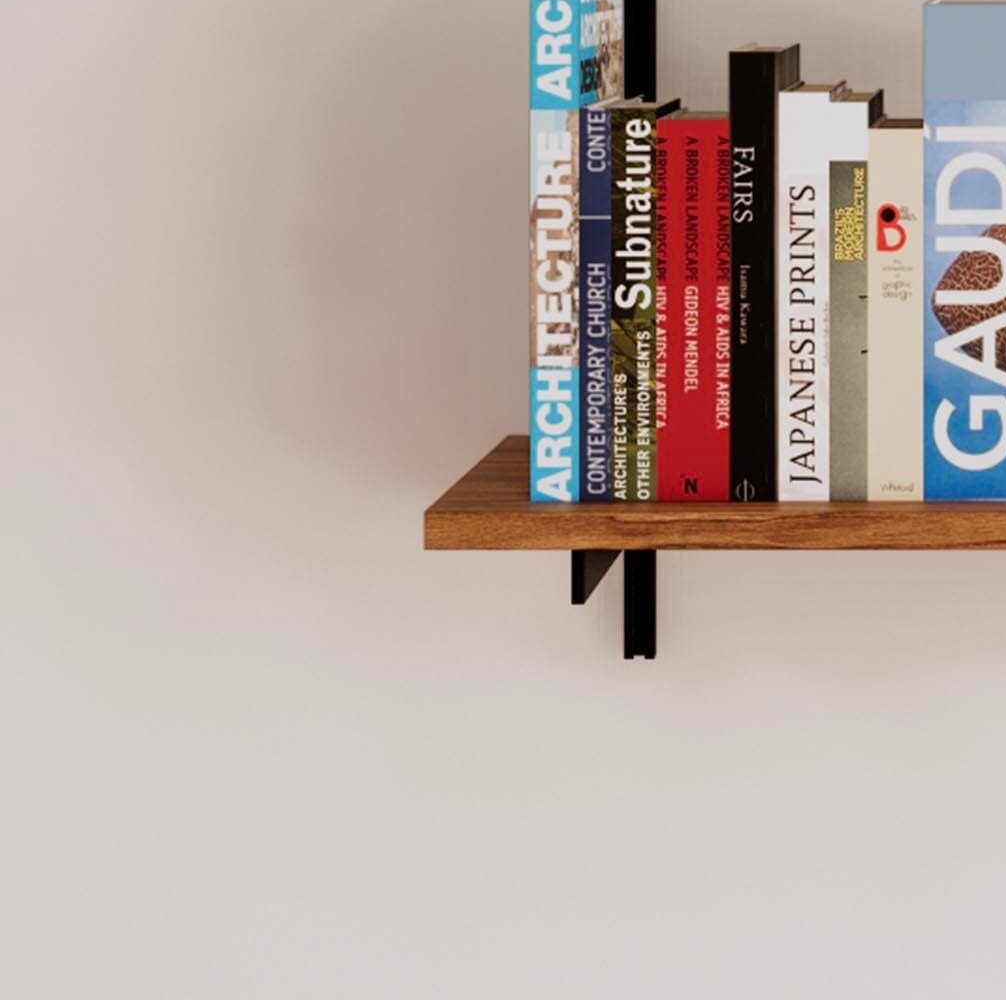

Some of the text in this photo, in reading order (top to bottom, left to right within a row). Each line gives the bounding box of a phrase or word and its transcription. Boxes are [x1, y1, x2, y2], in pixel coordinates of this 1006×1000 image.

[587, 107, 606, 173] CONTE
[615, 117, 652, 310] Subnature
[733, 147, 755, 223] FAIRS
[853, 168, 865, 261] ARCHITECTURE
[536, 131, 573, 501] ARCHITECTURE
[684, 136, 698, 393] A BROKEN LANDSCAPE GIDEON MENDEL
[716, 136, 730, 430] A BROKEN LANDSCAPE HIV & AIDS IN AFRICA
[789, 185, 823, 484] JAPANESE PRINTS
[587, 263, 606, 495] CONTEMPORARY CHURCH
[614, 373, 627, 500] ARCHITECTURE'S
[637, 331, 651, 500] OTHER ENVIRONMENTS
